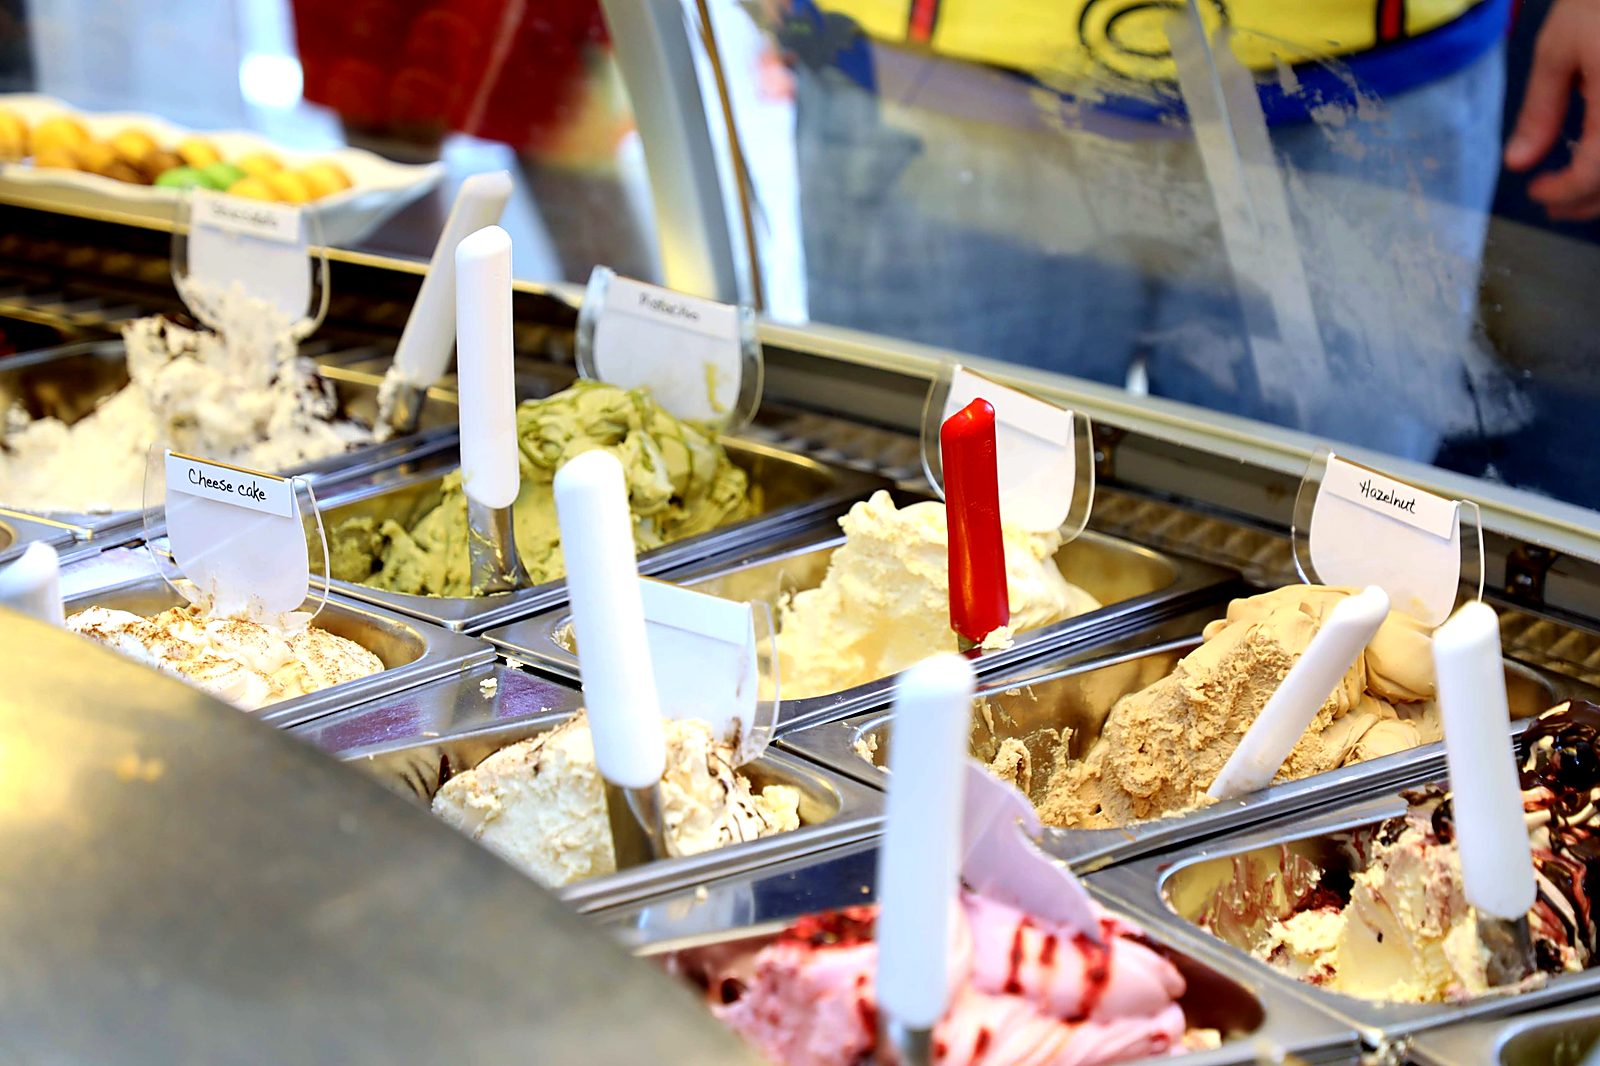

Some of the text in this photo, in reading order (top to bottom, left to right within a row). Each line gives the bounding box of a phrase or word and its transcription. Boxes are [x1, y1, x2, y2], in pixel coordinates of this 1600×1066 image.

[188, 468, 267, 502] Cheese cake
[1359, 479, 1416, 514] Hazelnut
